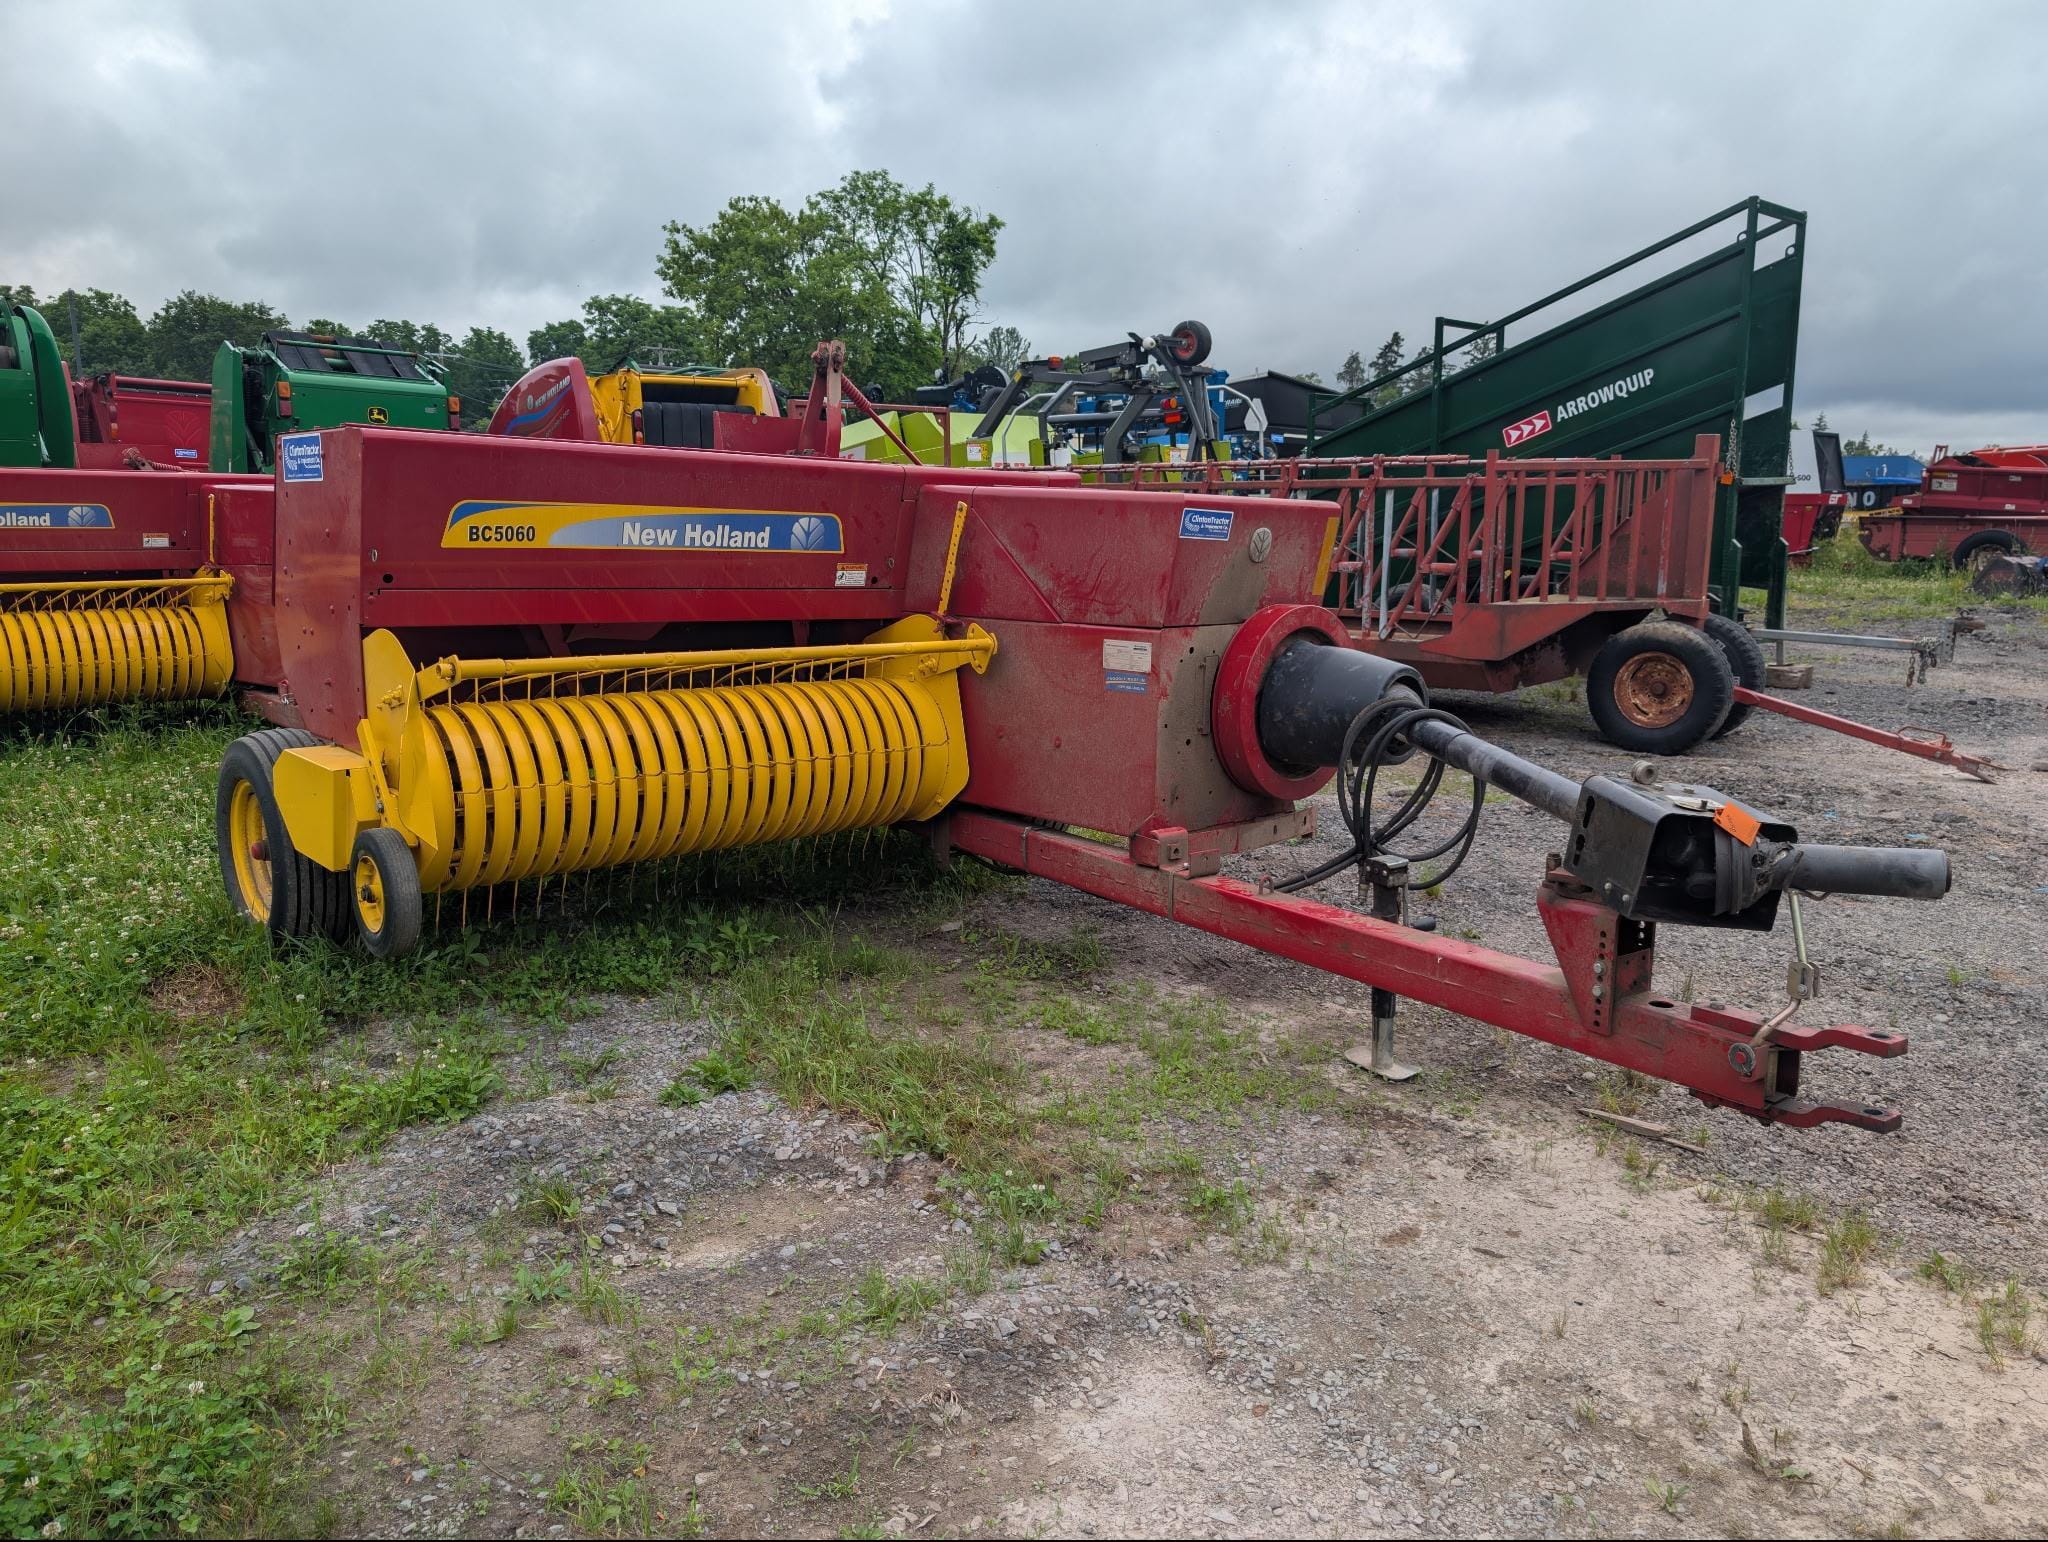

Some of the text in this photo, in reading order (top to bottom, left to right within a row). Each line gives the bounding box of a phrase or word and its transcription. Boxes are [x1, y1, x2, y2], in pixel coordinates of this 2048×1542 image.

[1556, 368, 1654, 422] ARROWQUIP
[468, 525, 536, 542] BC5060
[622, 522, 771, 548] New Holland
